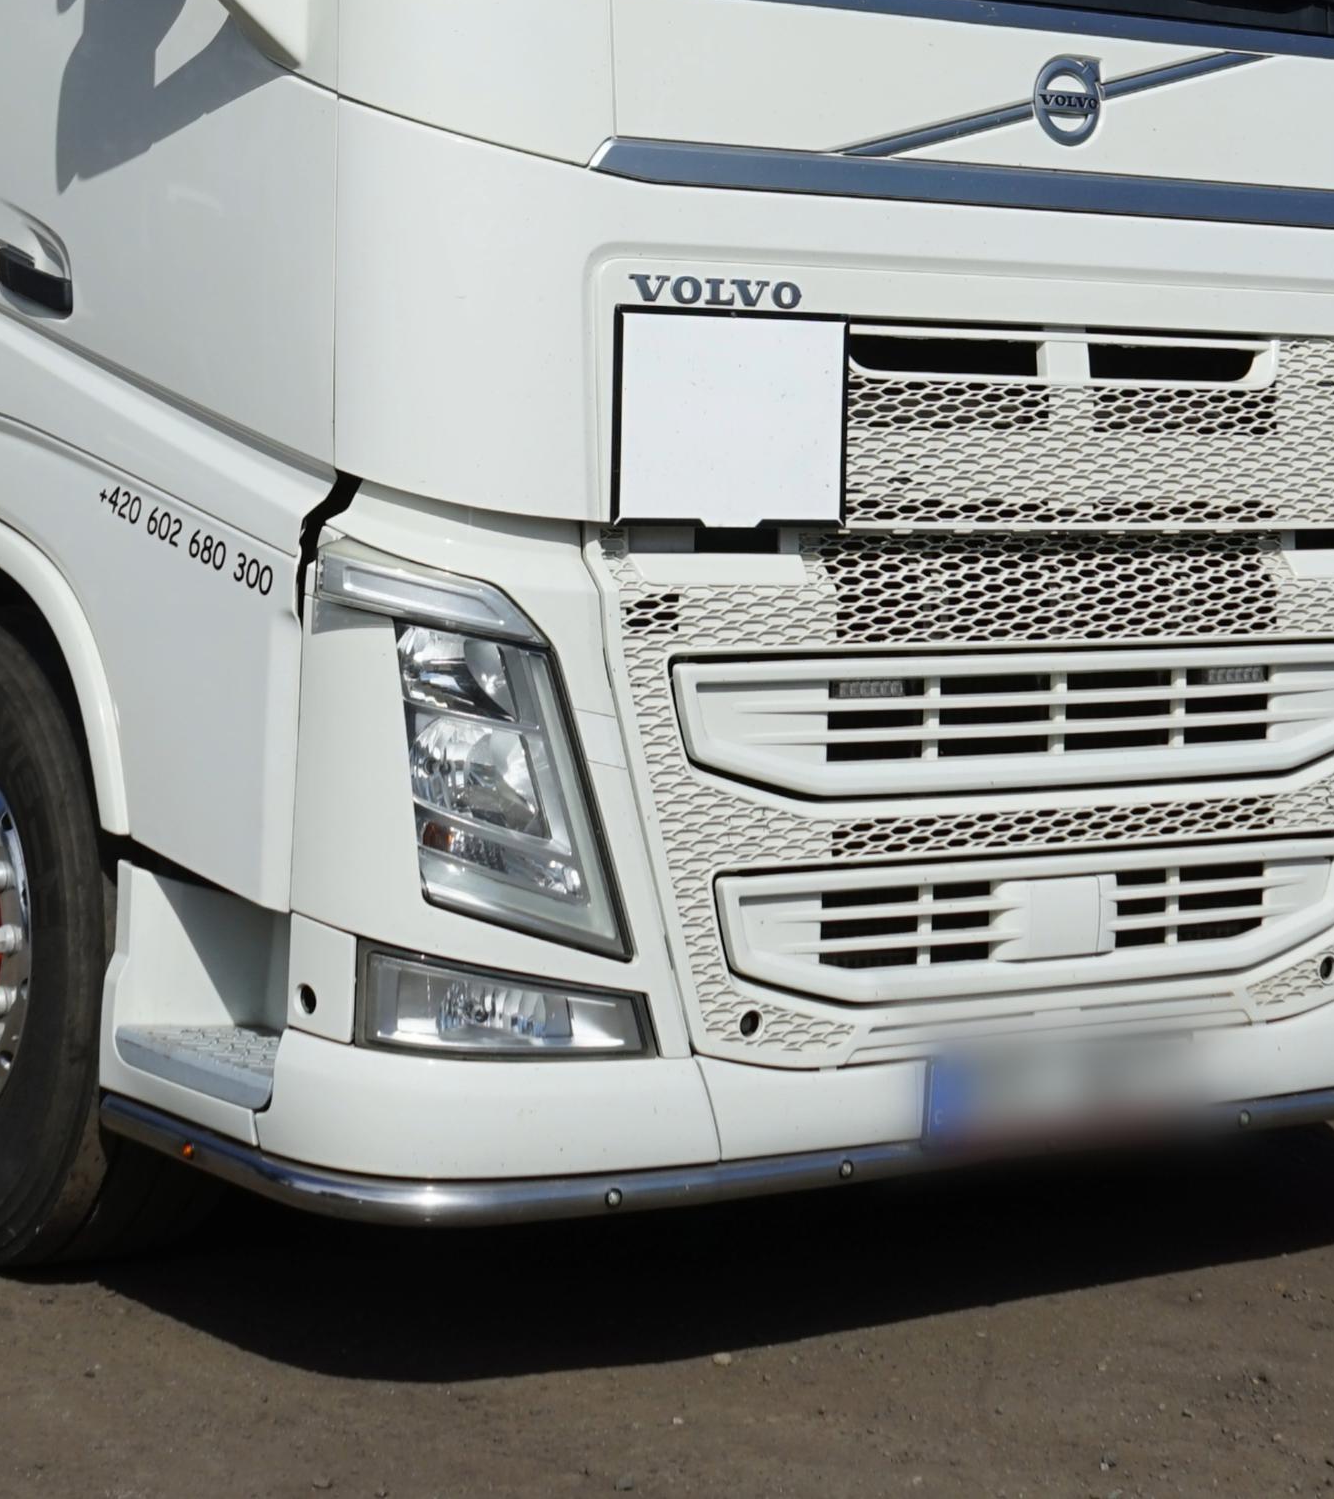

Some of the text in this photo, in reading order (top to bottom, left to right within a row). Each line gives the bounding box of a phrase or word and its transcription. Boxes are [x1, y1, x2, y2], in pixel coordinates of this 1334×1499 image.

[1038, 93, 1098, 110] VOLVO
[629, 274, 802, 310] VOLVO
[99, 486, 273, 595] +420 602 680 300
